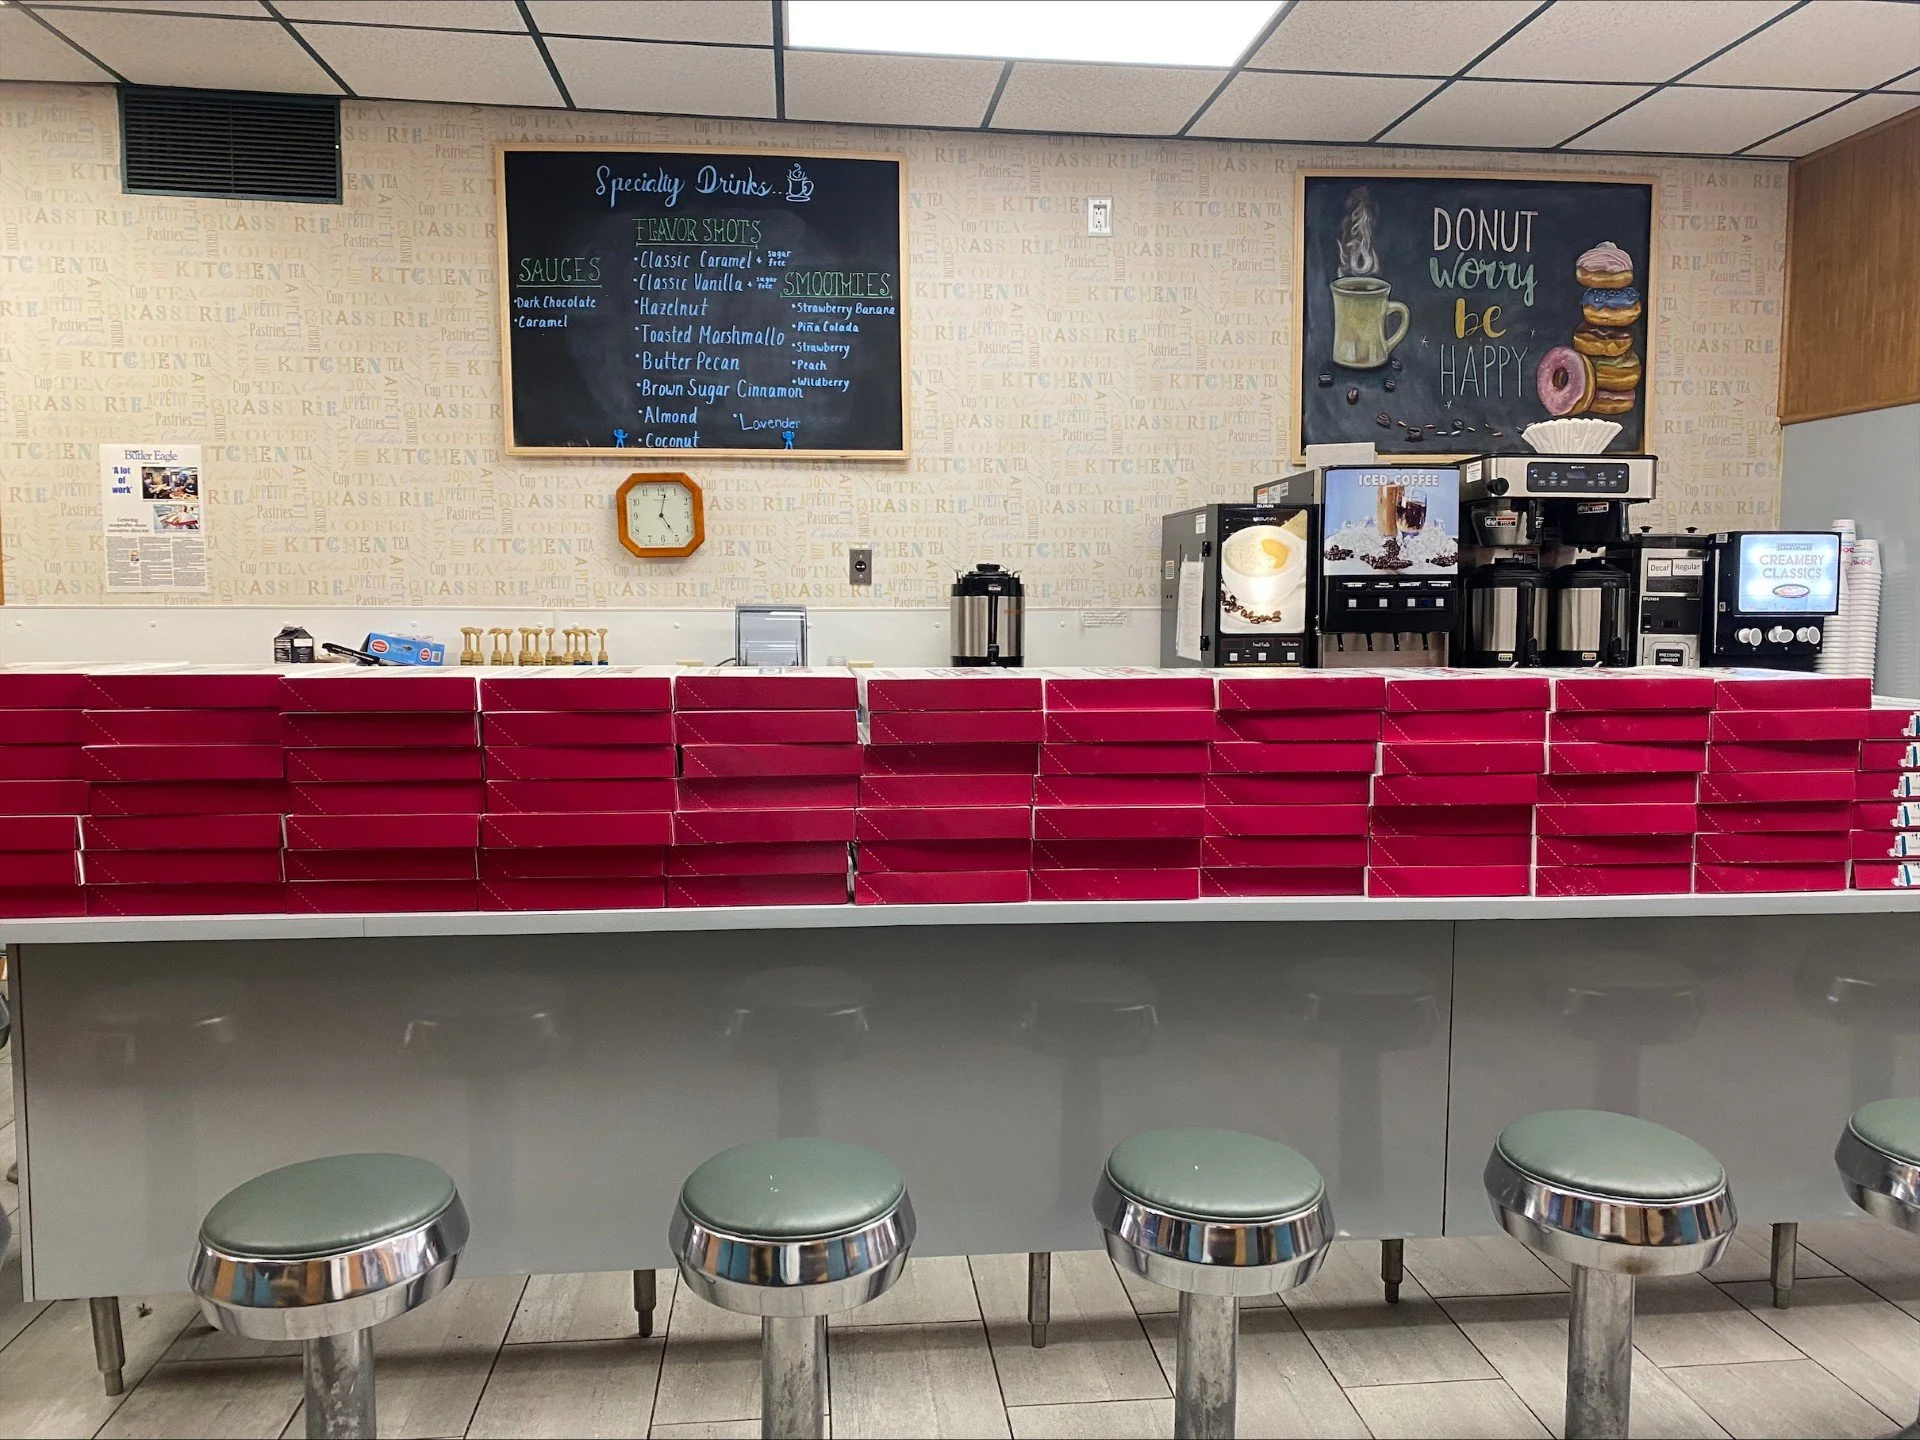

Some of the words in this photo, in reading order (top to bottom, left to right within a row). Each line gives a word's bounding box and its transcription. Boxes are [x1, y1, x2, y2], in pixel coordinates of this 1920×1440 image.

[42, 129, 78, 143] Pastries
[435, 145, 470, 159] Pastries
[978, 164, 1010, 178] Pastries
[380, 174, 397, 188] TEA
[596, 165, 685, 208] Specialty
[1172, 201, 1262, 218] KITCHEN
[632, 218, 698, 241] FLAVOR
[703, 219, 761, 243] SHOTS
[1433, 207, 1539, 252] DONUT
[343, 233, 378, 248] Pastries
[89, 257, 108, 272] TEA
[640, 251, 690, 269] Classic
[700, 250, 752, 269] Caramel
[768, 258, 786, 267] free
[1232, 258, 1262, 271] Pastries
[176, 261, 281, 280] KITCHEN
[370, 267, 472, 285] KITCHEN
[519, 257, 600, 281] SAUCES
[639, 274, 687, 291] Classic
[695, 273, 743, 292] Vanilla
[783, 272, 890, 296] SMOOTHIES
[327, 290, 343, 305] Cup
[1013, 284, 1030, 297] TEA
[1088, 286, 1178, 302] KITCHEN
[517, 296, 540, 308] Dark
[543, 296, 596, 308] Chocolate
[640, 297, 709, 316] Hazelnut
[797, 302, 852, 320] Strawberry
[855, 302, 895, 315] Banana
[1454, 297, 1506, 339] be
[52, 317, 88, 332] Pastries
[519, 315, 567, 328] Caramel
[797, 321, 820, 332] Piña
[823, 321, 859, 332] Colada
[441, 328, 476, 342] Pastries
[641, 324, 692, 343] Toasted
[699, 325, 785, 346] Marshmallo
[797, 342, 850, 359] Strawberry
[978, 341, 1010, 354] Pastries
[81, 351, 187, 369] KITCHEN
[193, 352, 212, 368] TEA
[277, 356, 381, 374] KITCHEN
[387, 357, 404, 371] TEA
[642, 351, 692, 370] Butter
[696, 351, 740, 371] Pecan
[797, 359, 827, 370] Peach
[1440, 344, 1528, 398] HAPPY
[34, 375, 51, 390] Cup
[797, 377, 850, 392] Wildberry
[1002, 372, 1093, 388] KITCHEN
[1170, 374, 1259, 390] KITCHEN
[1736, 381, 1750, 394] TEA
[642, 378, 683, 396] Brown
[688, 378, 730, 404] Sugar
[737, 379, 803, 398] Cinnamon
[962, 395, 976, 408] Cup
[155, 413, 192, 427] Pastries
[644, 406, 698, 424] Almond
[740, 412, 800, 431] Lavender
[350, 416, 385, 430] Pastries
[646, 431, 700, 448] Coconut
[1062, 428, 1094, 442] Pastries
[1702, 433, 1731, 446] Pastries
[125, 450, 152, 460] Butler
[154, 450, 178, 462] Eagle
[294, 446, 312, 460] TEA
[376, 448, 477, 465] KITCHEN
[917, 458, 1008, 473] KITCHEN
[1012, 458, 1028, 471] TEA
[1085, 458, 1175, 475] KITCHEN
[333, 472, 349, 485] Cup
[1358, 474, 1387, 486] ICED
[1394, 474, 1439, 486] COFFEE
[1046, 481, 1060, 496] Cup
[257, 505, 293, 518] Pastries
[447, 507, 481, 520] Pastries
[808, 512, 839, 525] Pastries
[978, 513, 1009, 526] Pastries
[284, 536, 387, 553] KITCHEN
[473, 538, 572, 554] KITCHEN
[576, 539, 593, 552] TEA
[1001, 543, 1091, 558] KITCHEN
[1760, 555, 1825, 565] CREAMERY
[430, 562, 446, 575] Cup
[1763, 568, 1822, 579] CLASSICS
